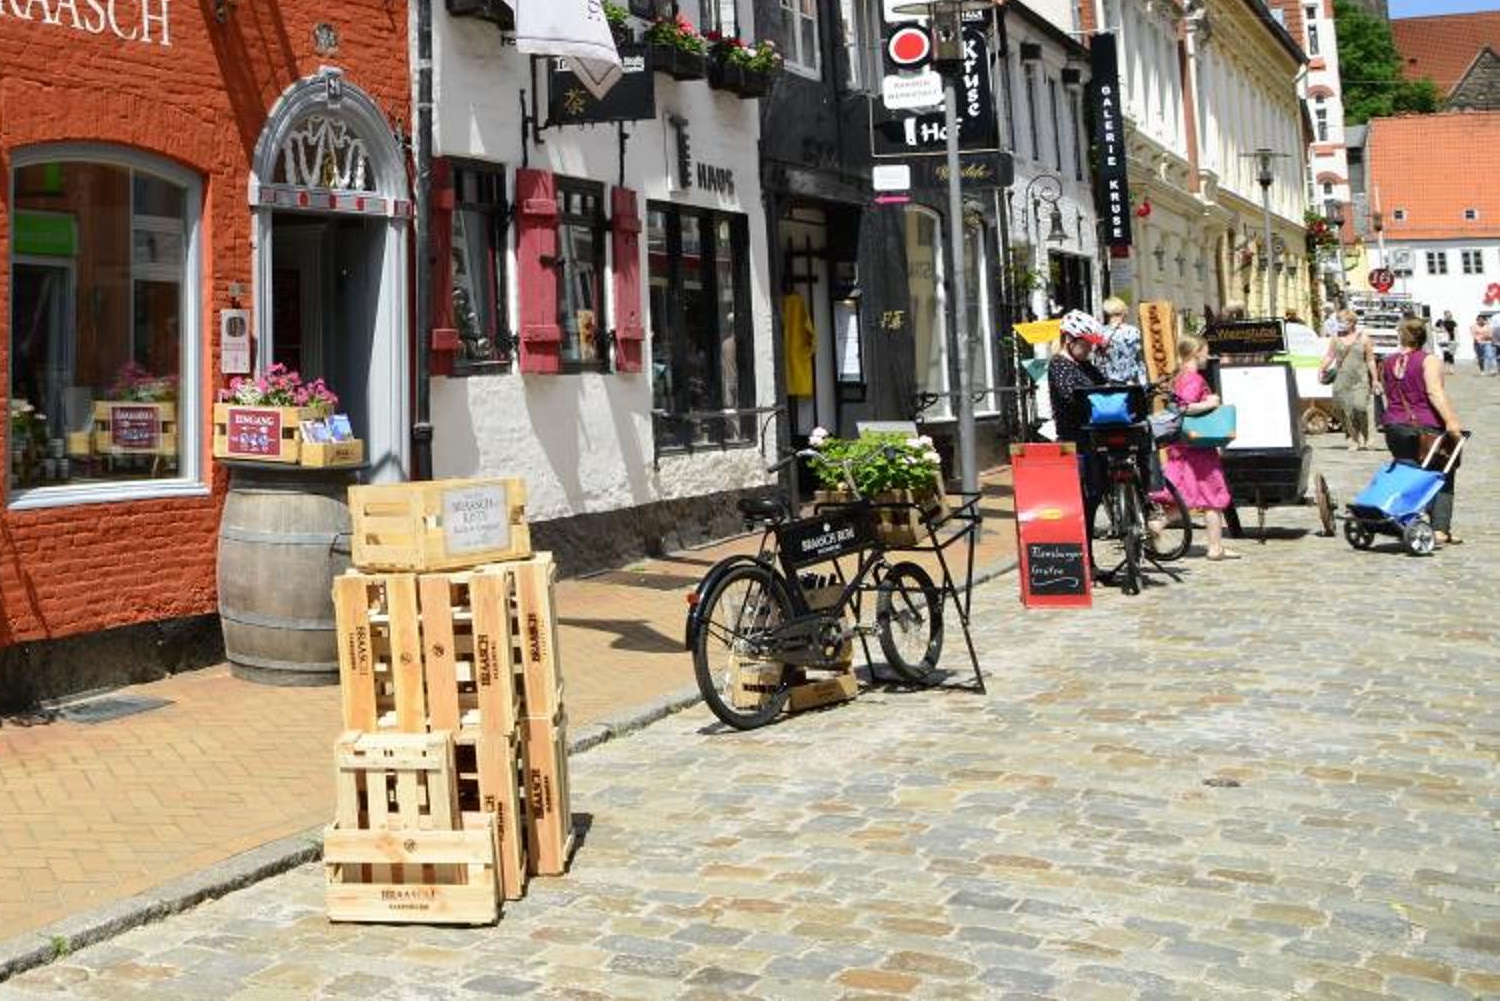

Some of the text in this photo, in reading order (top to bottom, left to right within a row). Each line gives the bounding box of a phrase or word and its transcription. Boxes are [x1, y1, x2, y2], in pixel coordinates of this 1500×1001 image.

[1100, 85, 1118, 167] GALERIE
[1108, 179, 1123, 239] KRUSE
[234, 414, 275, 426] EINGANG
